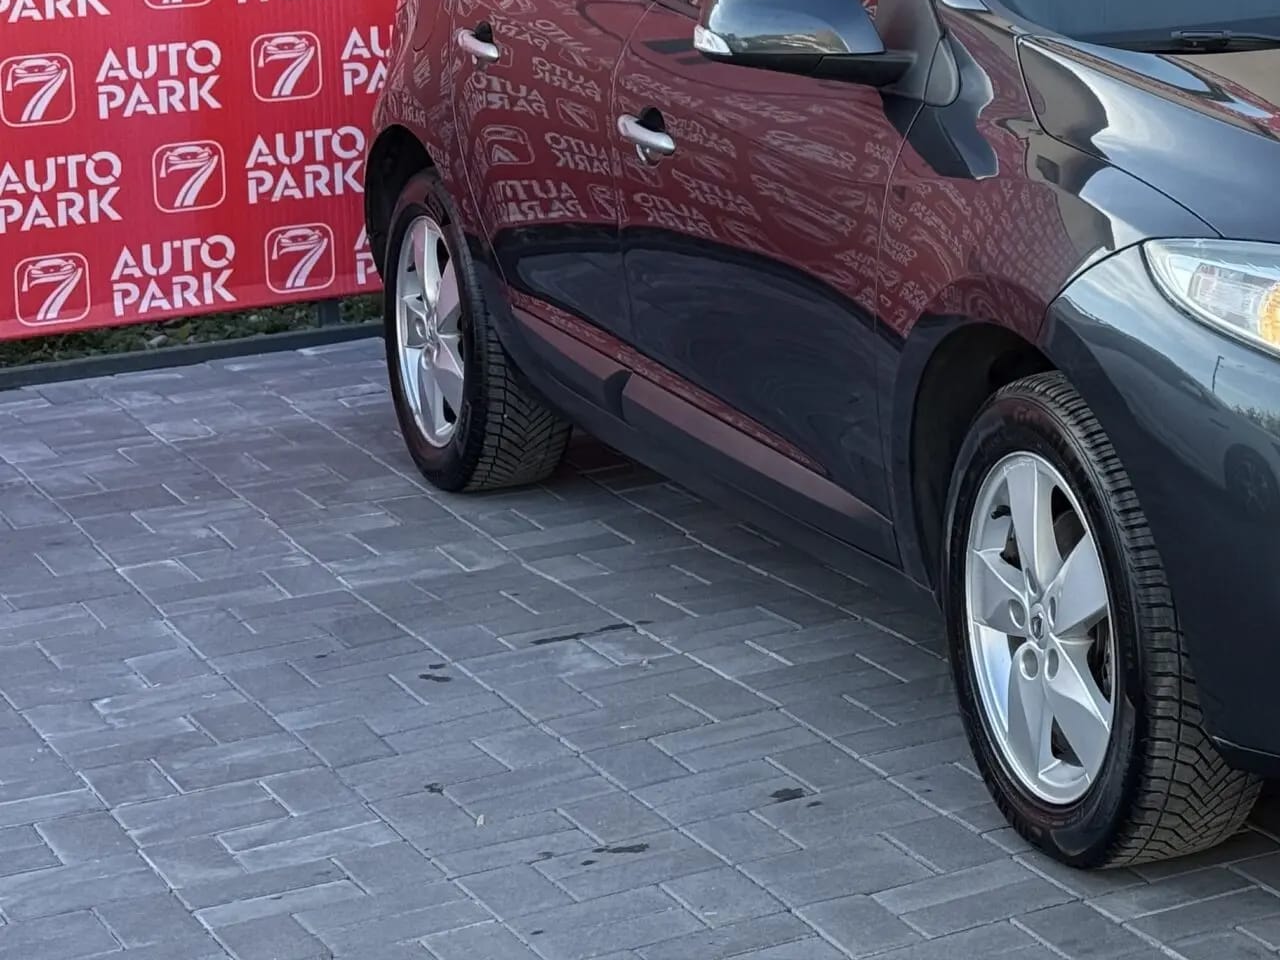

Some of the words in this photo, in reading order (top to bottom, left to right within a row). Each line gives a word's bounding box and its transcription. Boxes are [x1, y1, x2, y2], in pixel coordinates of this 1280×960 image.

[96, 39, 222, 83] AUTO
[97, 75, 223, 120] PARK
[245, 126, 365, 169] AUTO
[0, 152, 122, 196] AUTO
[247, 160, 365, 204] PARK
[0, 187, 123, 234] PARK
[111, 235, 235, 281] AUTO
[112, 269, 237, 317] PARK
